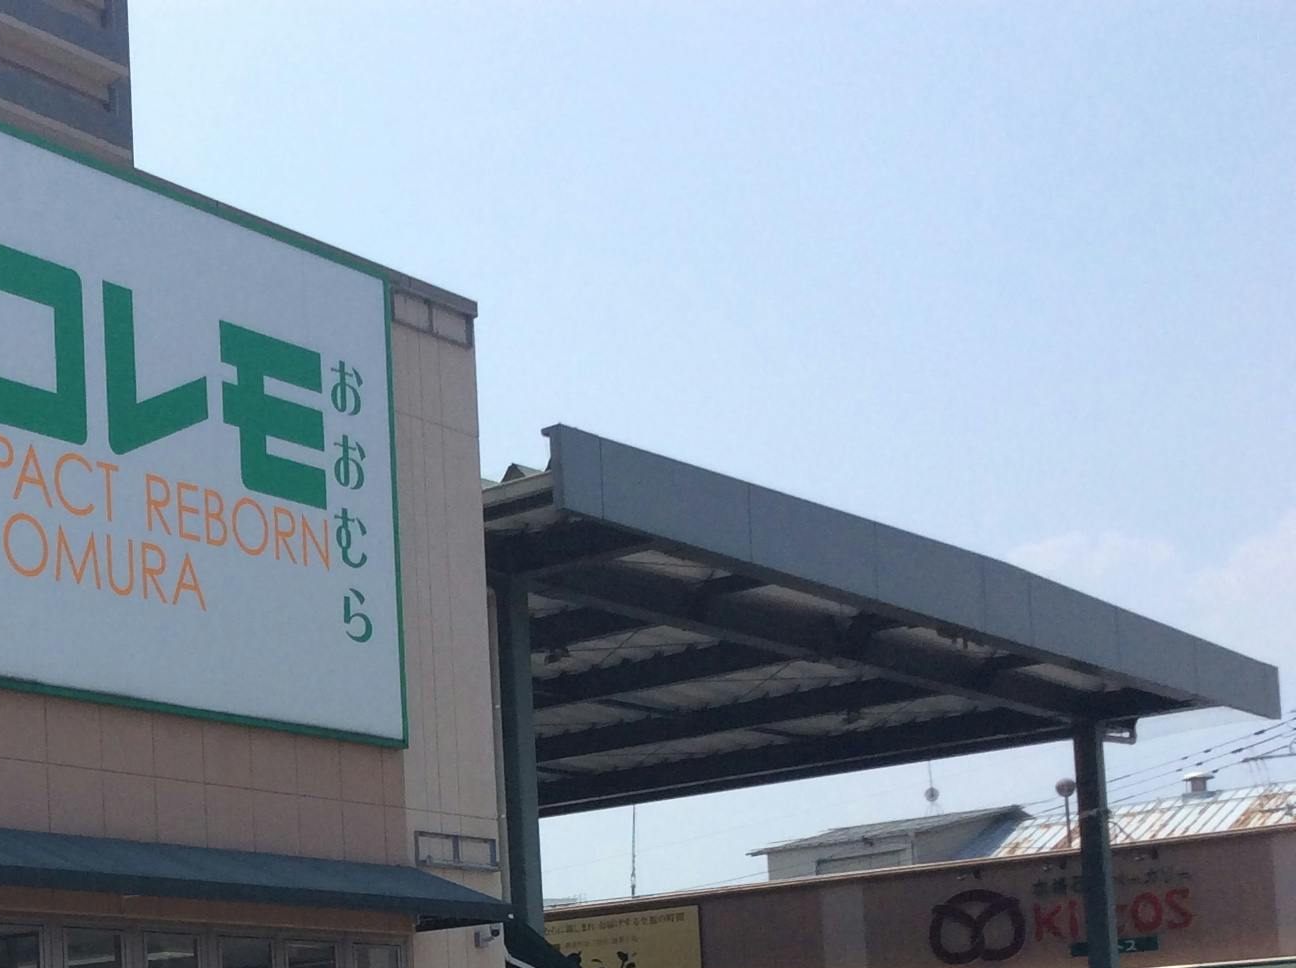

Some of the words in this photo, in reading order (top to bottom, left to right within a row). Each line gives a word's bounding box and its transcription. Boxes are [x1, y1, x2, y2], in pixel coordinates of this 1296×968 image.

[144, 473, 332, 571] REBORN
[330, 359, 374, 644] おおむら
[3, 512, 207, 612] OMURA
